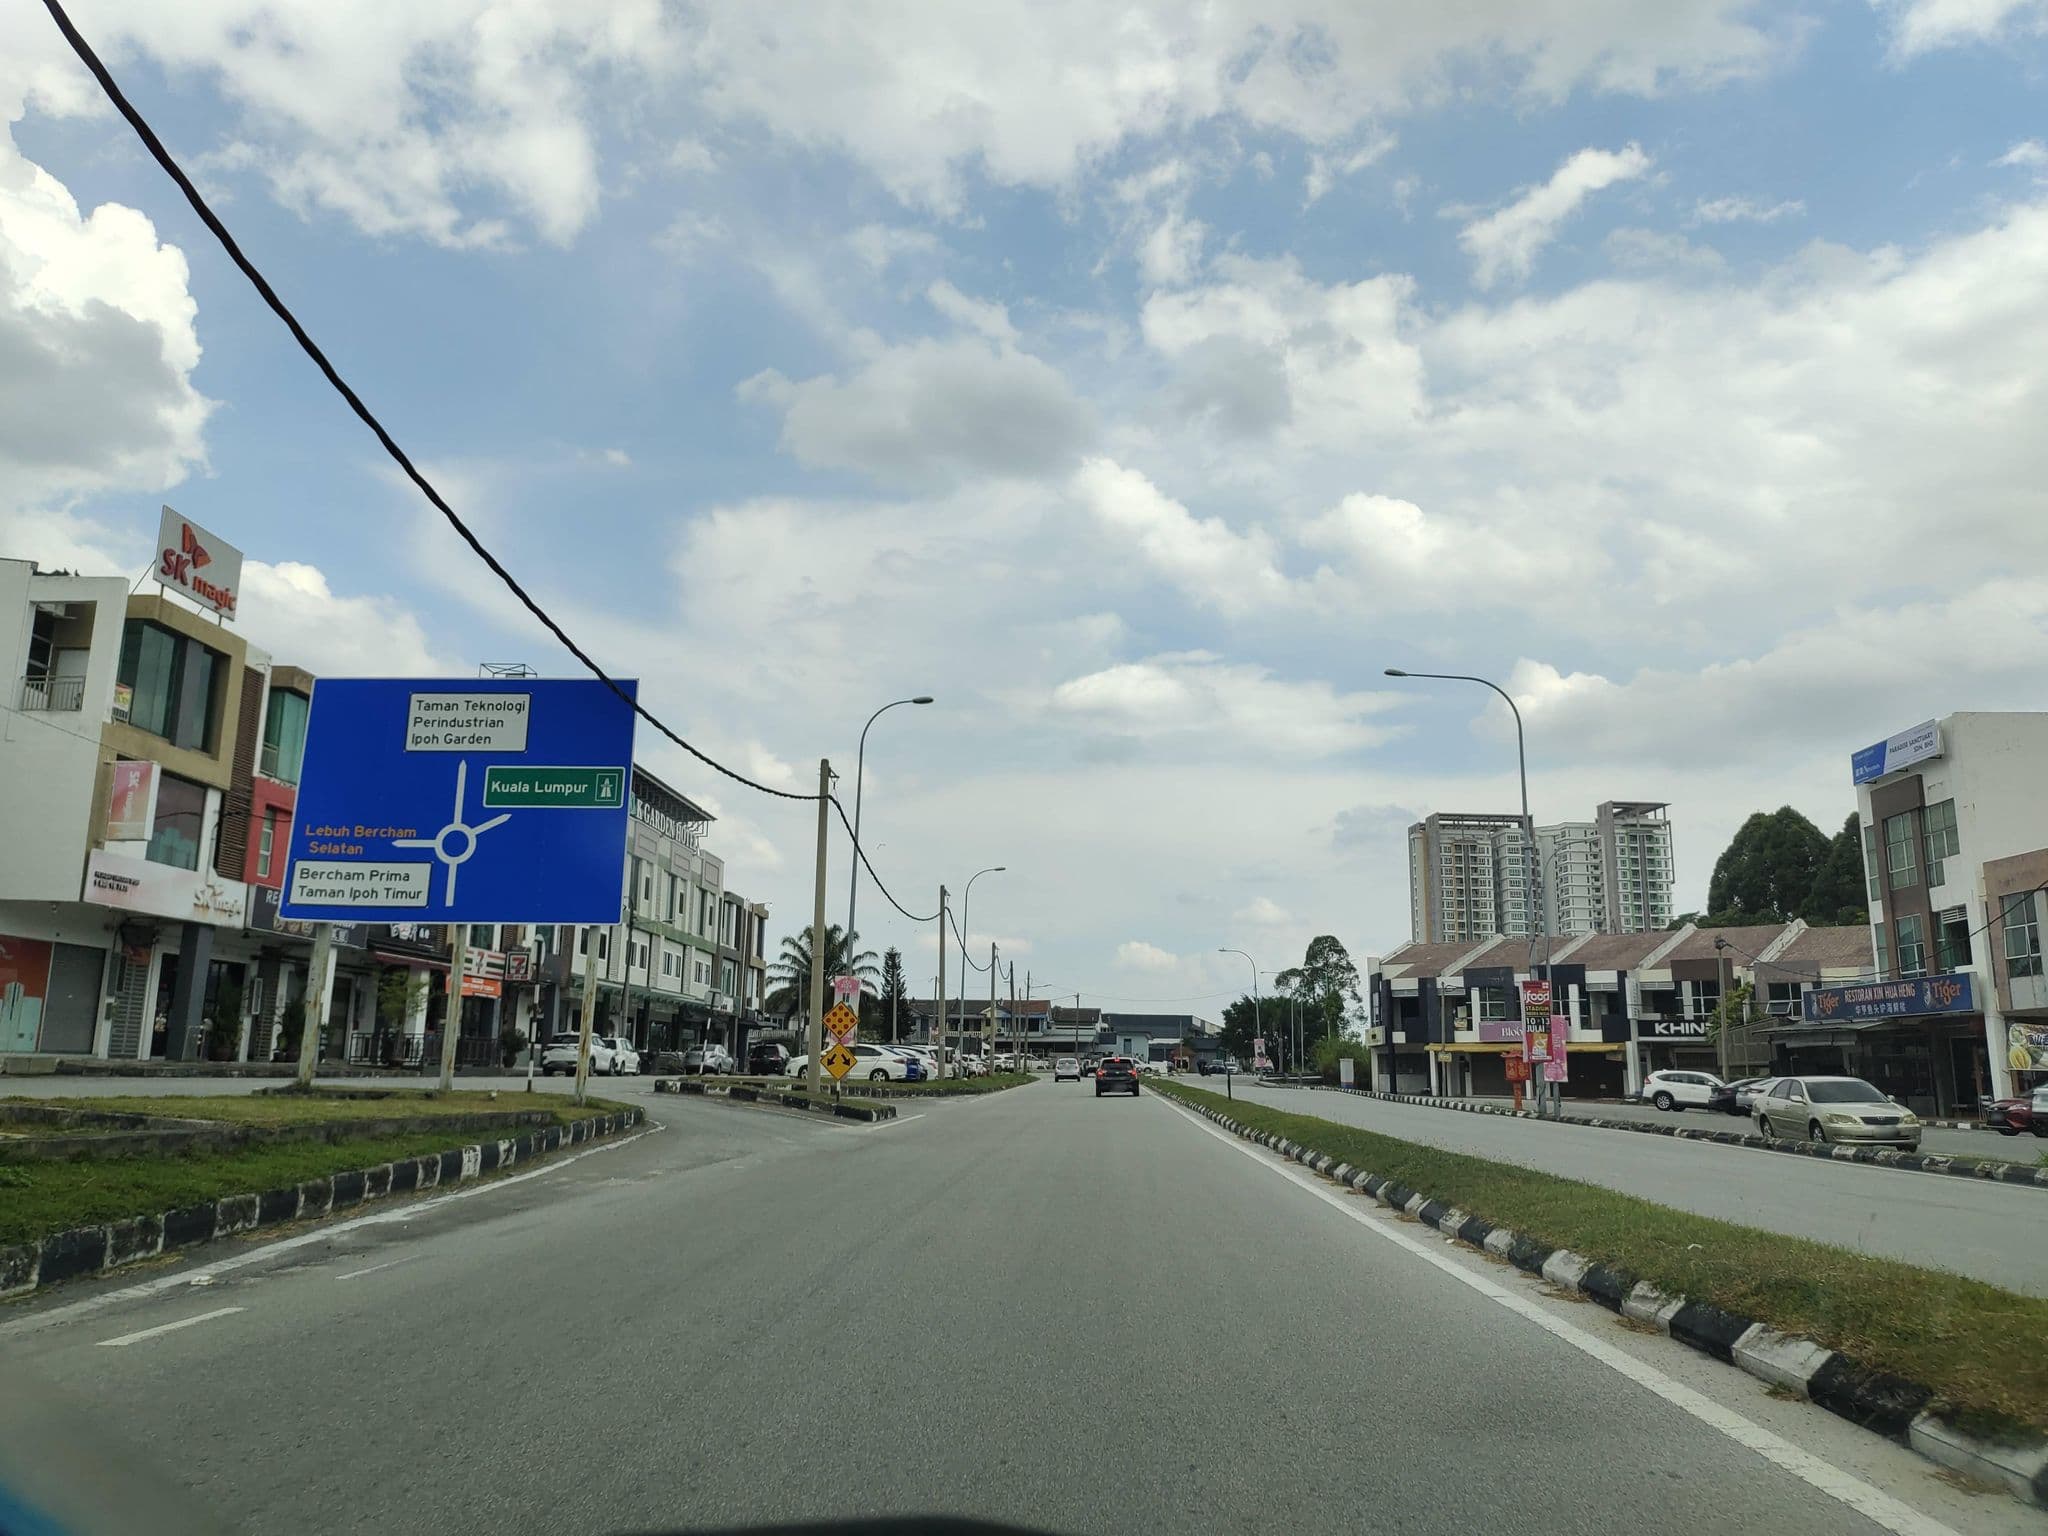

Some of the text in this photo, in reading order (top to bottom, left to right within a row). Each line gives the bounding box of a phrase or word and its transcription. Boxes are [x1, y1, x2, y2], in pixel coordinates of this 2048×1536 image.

[161, 548, 236, 611] SK magic
[416, 700, 526, 714] Taman Teknologi
[413, 717, 504, 728] Perindustrian
[411, 733, 492, 746] Ipoh Garden
[491, 781, 588, 796] Kuala Lumpur
[644, 803, 675, 839] GARDEN
[305, 824, 417, 838] Lebuh Bercham
[309, 841, 363, 854] Selatan
[299, 868, 410, 882] Bercham Prima
[299, 886, 423, 901] Taman Ipoh Timur
[1818, 992, 1839, 1016] Tiger
[1844, 988, 1872, 1003] RESTORAN
[1899, 983, 1916, 998] HENG
[1933, 979, 1961, 1004] Tiger
[1526, 1017, 1536, 1025] 10
[1526, 1024, 1545, 1032] JULAI
